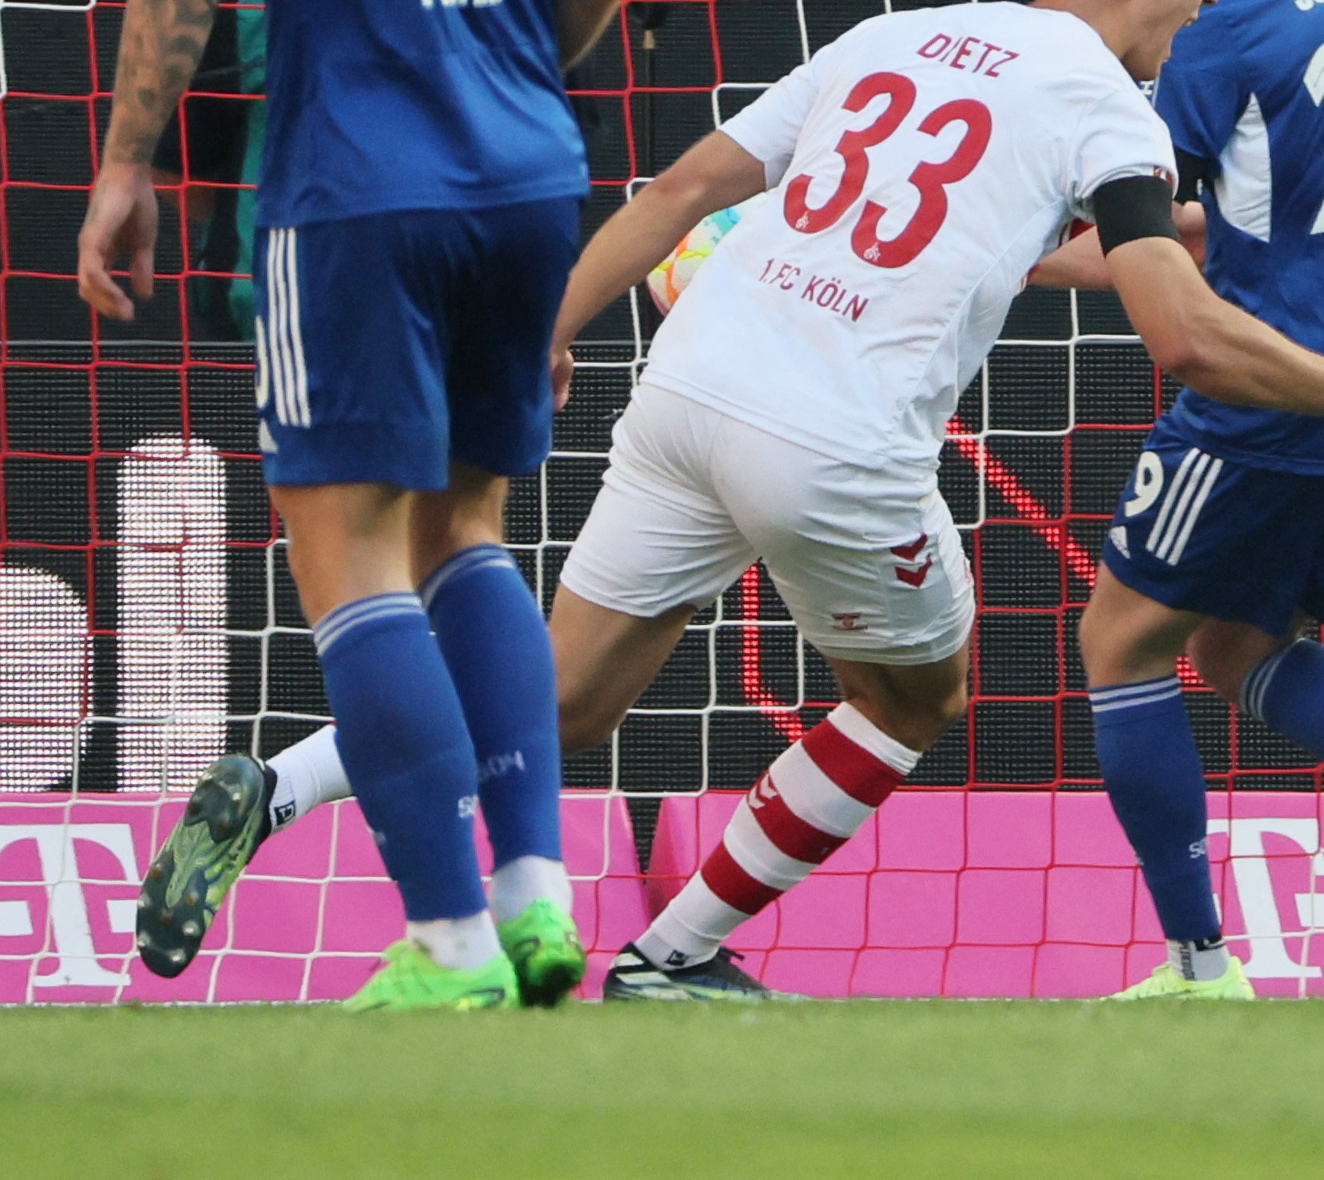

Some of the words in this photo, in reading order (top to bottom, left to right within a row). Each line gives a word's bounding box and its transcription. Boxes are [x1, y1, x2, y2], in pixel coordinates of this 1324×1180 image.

[917, 33, 1019, 78] DIETZ
[783, 72, 992, 269] 33
[801, 276, 869, 322] KÖLN
